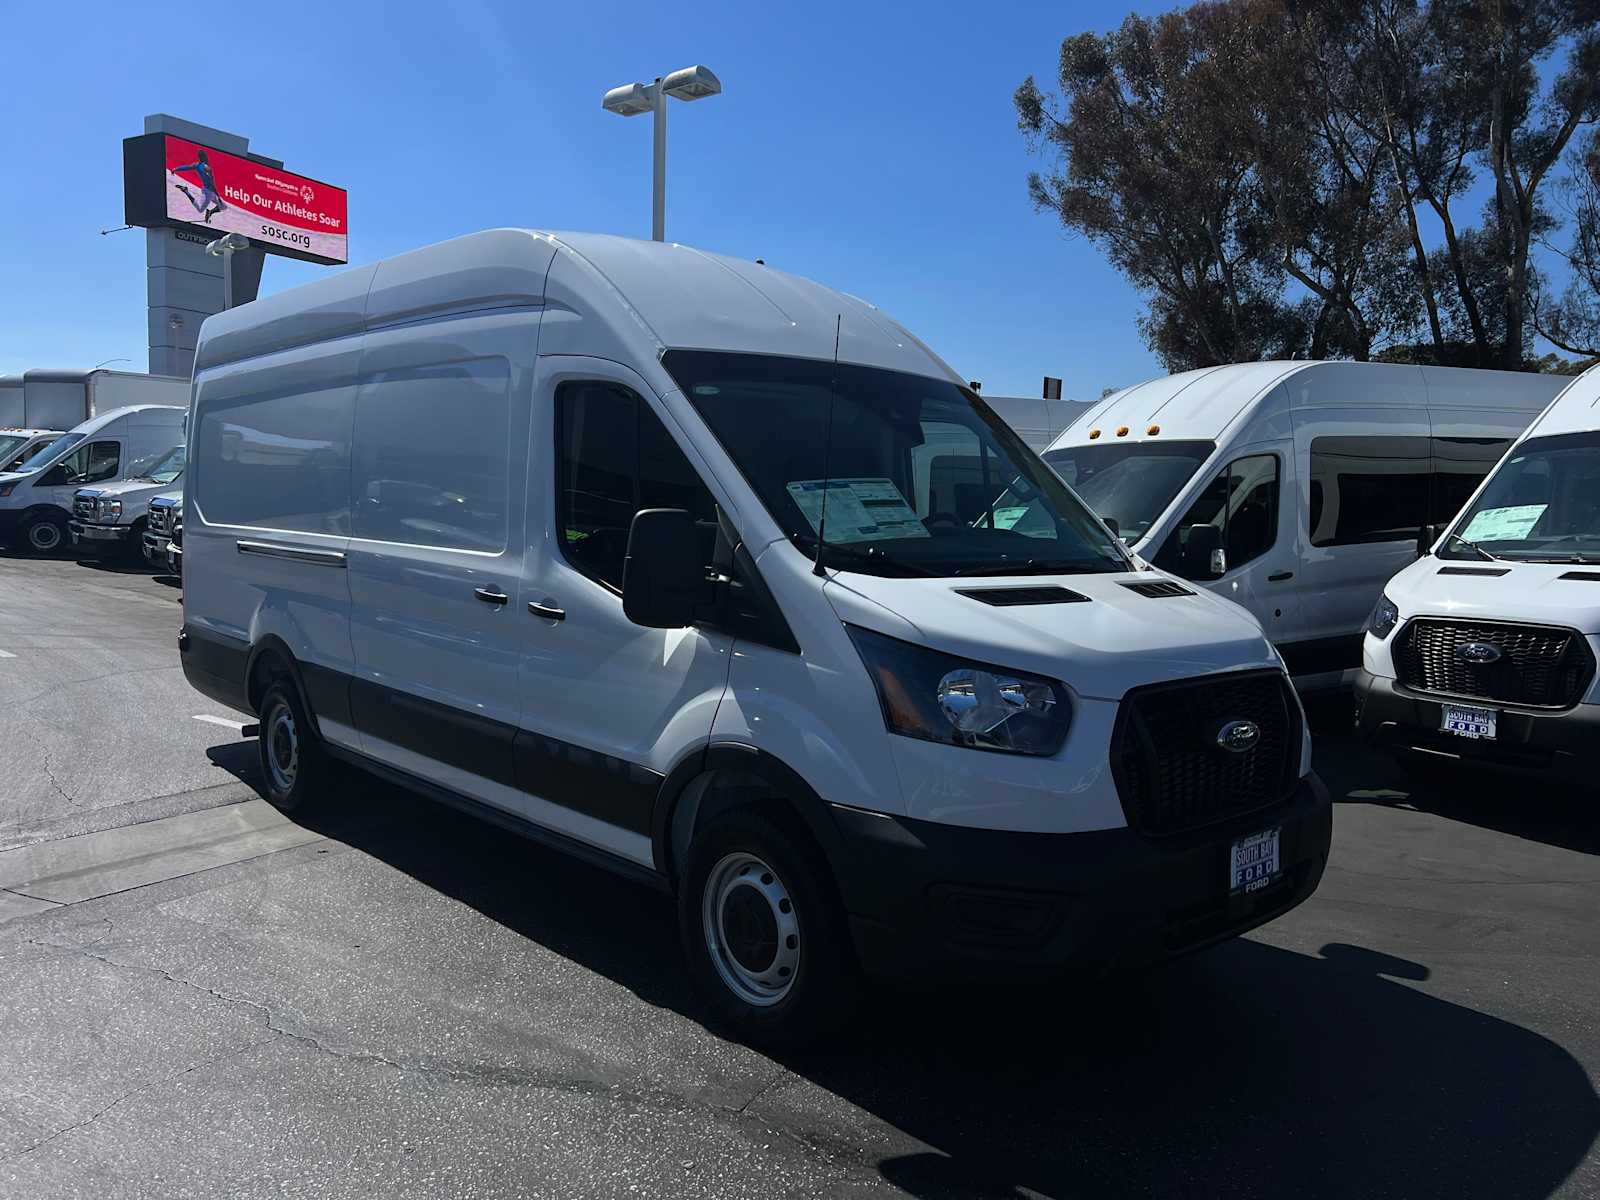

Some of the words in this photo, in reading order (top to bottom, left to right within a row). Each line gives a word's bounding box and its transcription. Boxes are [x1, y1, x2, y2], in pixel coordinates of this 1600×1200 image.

[225, 185, 250, 204] Help
[253, 194, 272, 209] Our
[274, 200, 317, 222] Athletes
[319, 213, 341, 228] Soar
[262, 225, 310, 248] sosc.org
[1449, 721, 1488, 734] FORD
[1236, 842, 1259, 866] SOUTH
[1260, 839, 1273, 858] BAY
[1236, 860, 1273, 885] FORD
[1246, 876, 1270, 894] FORD
